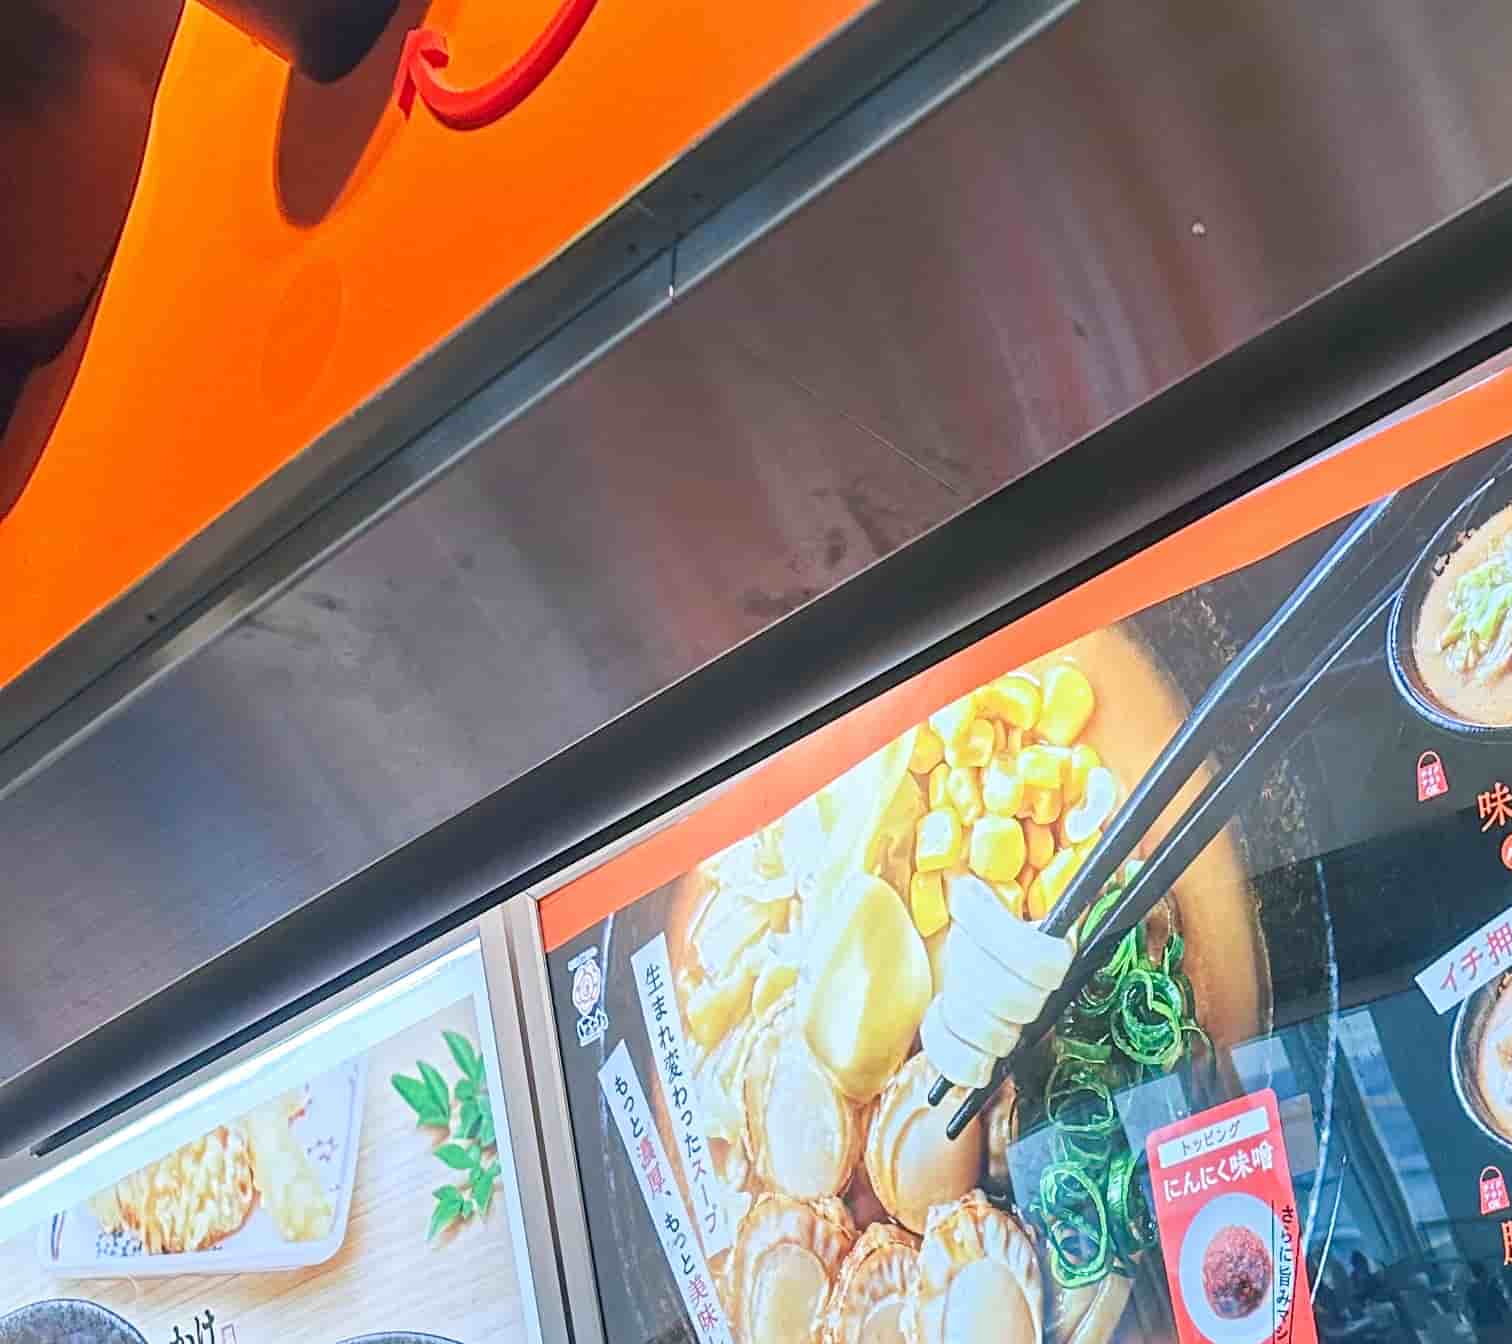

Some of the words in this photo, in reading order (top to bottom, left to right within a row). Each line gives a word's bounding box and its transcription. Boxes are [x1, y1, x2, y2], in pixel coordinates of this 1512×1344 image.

[644, 965, 718, 1236] 生まれ変わったスープ
[1182, 1119, 1241, 1155] トッピング
